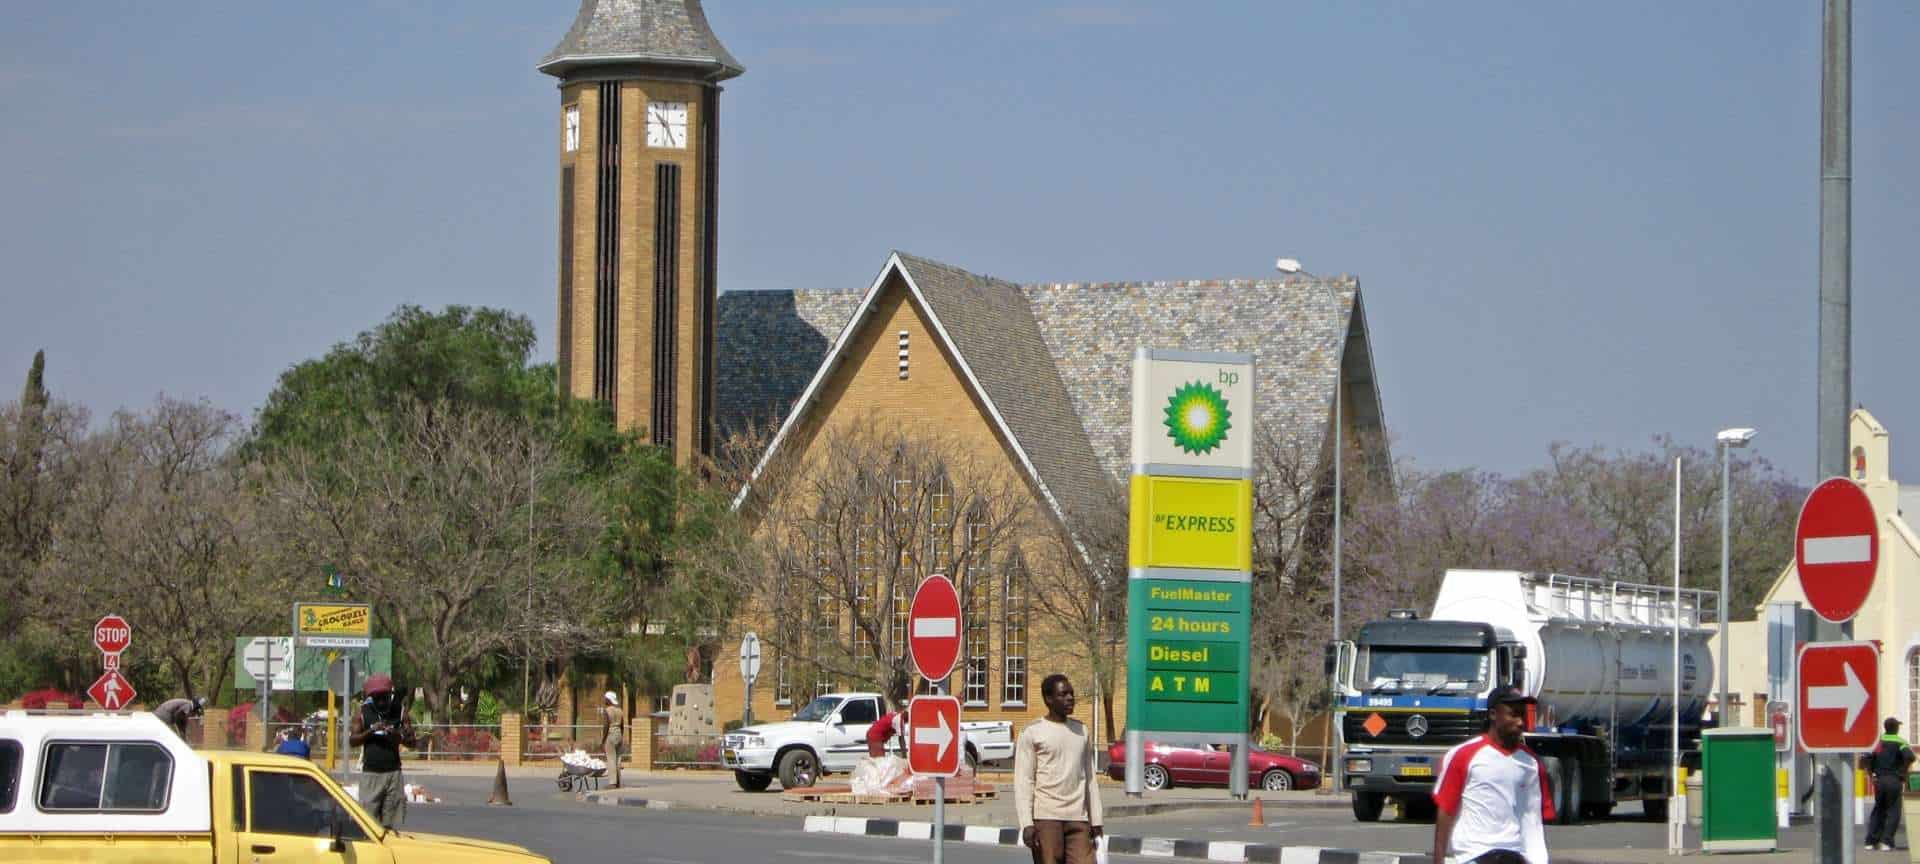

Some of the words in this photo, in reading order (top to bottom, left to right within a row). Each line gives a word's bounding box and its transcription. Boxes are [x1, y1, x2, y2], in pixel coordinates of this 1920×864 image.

[1219, 368, 1239, 386] bp
[1166, 515, 1235, 532] EXPRESS
[1151, 587, 1232, 601] FuelMaster
[1151, 616, 1175, 631] 24
[1179, 617, 1231, 633] hours
[98, 628, 127, 642] STOP
[108, 655, 116, 667] 4
[1150, 645, 1208, 662] Diesel
